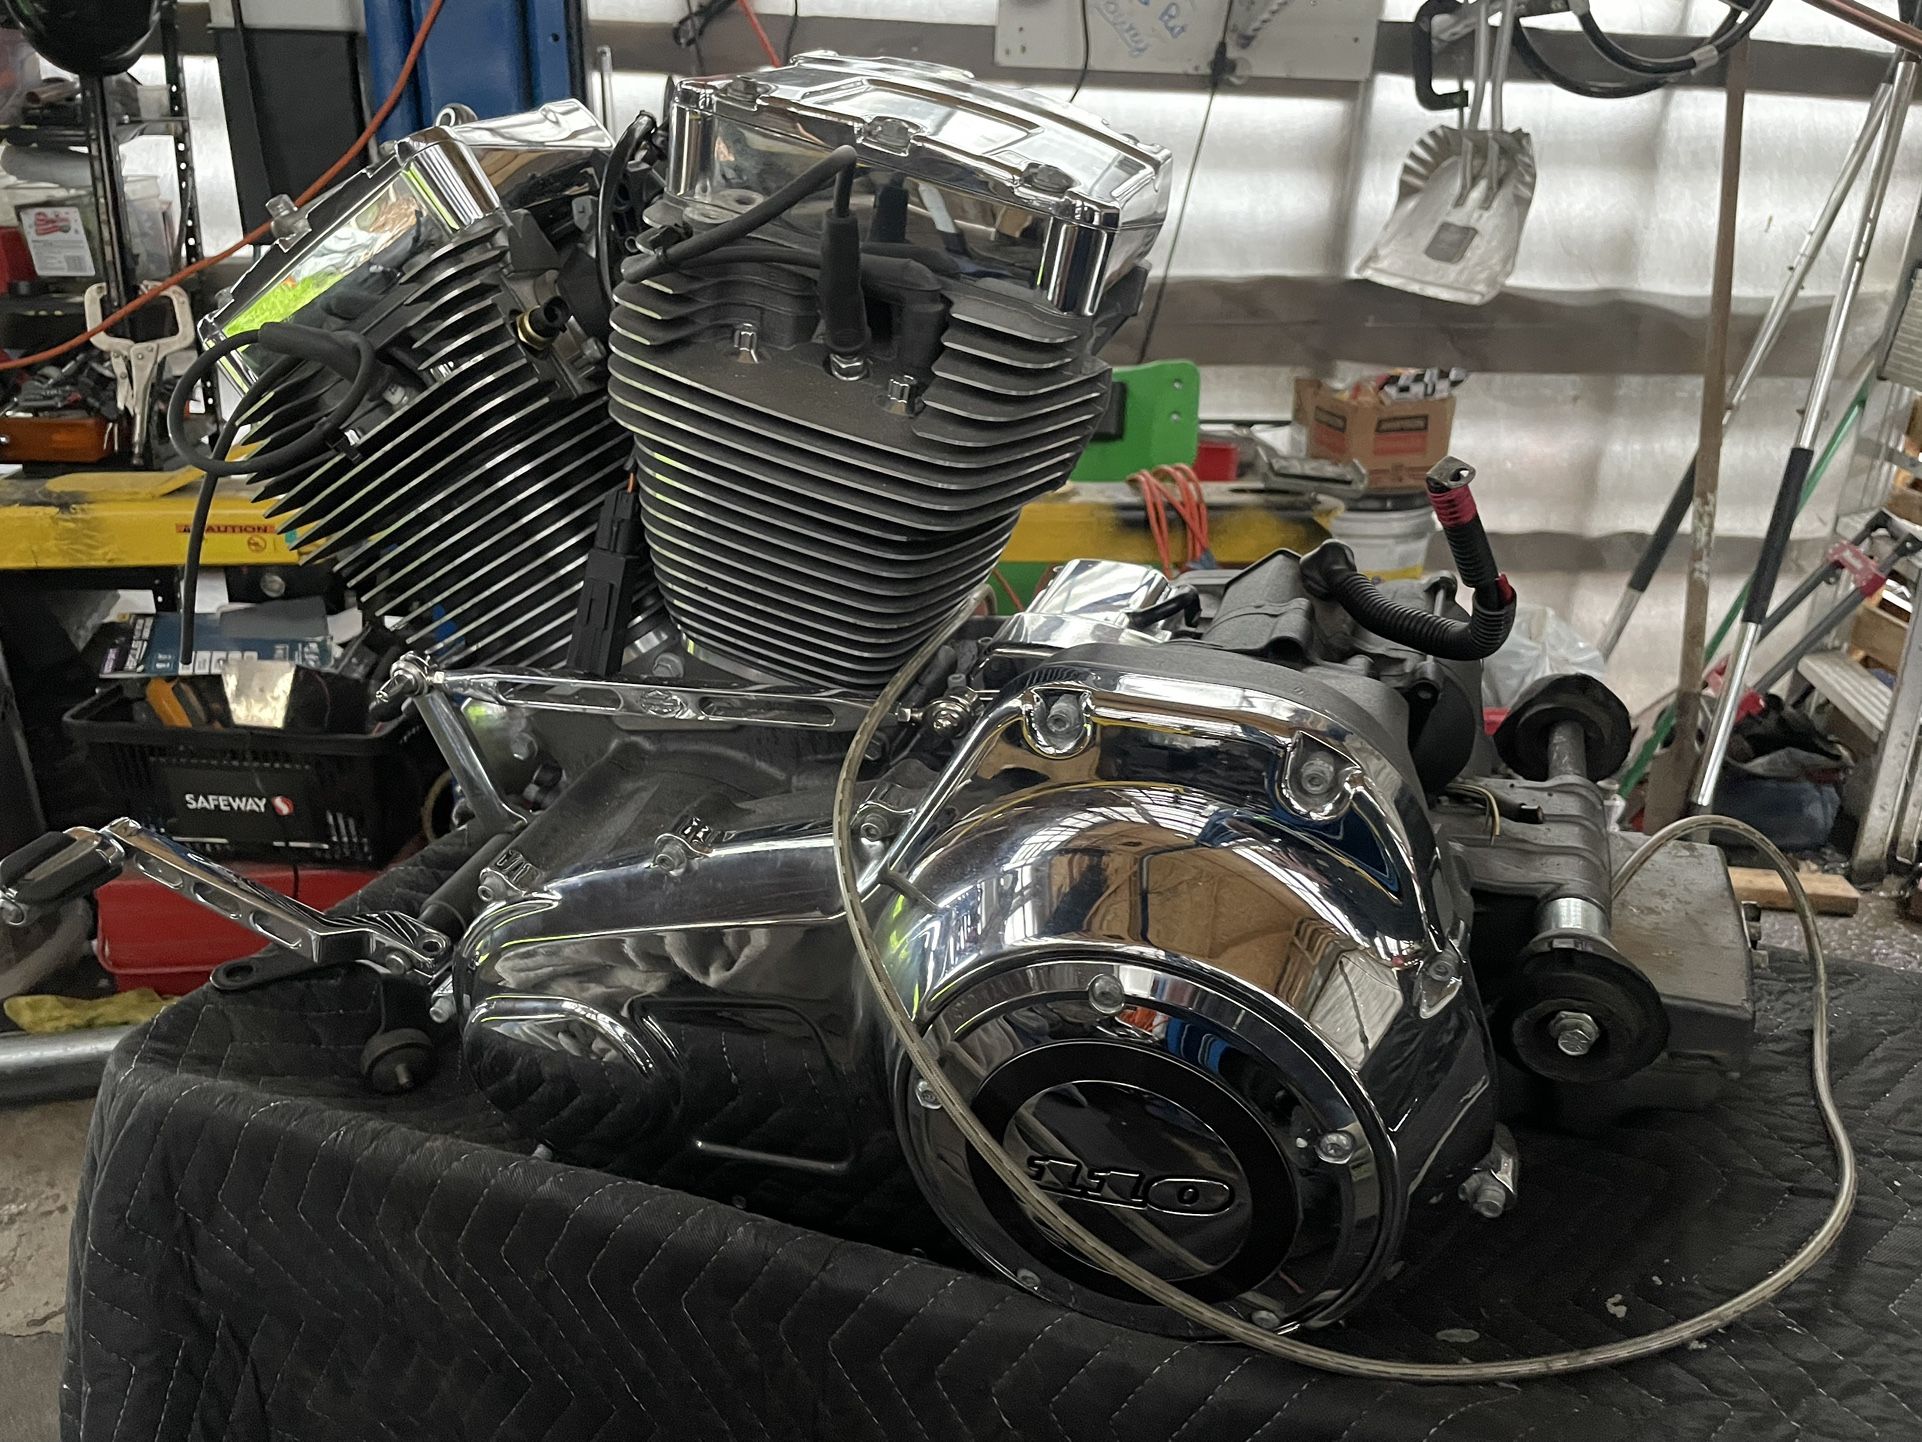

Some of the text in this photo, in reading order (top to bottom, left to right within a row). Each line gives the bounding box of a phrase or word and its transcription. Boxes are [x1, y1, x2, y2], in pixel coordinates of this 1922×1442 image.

[205, 524, 268, 534] AUTION
[185, 793, 267, 813] SAFEWAY
[1027, 1155, 1234, 1217] 110
